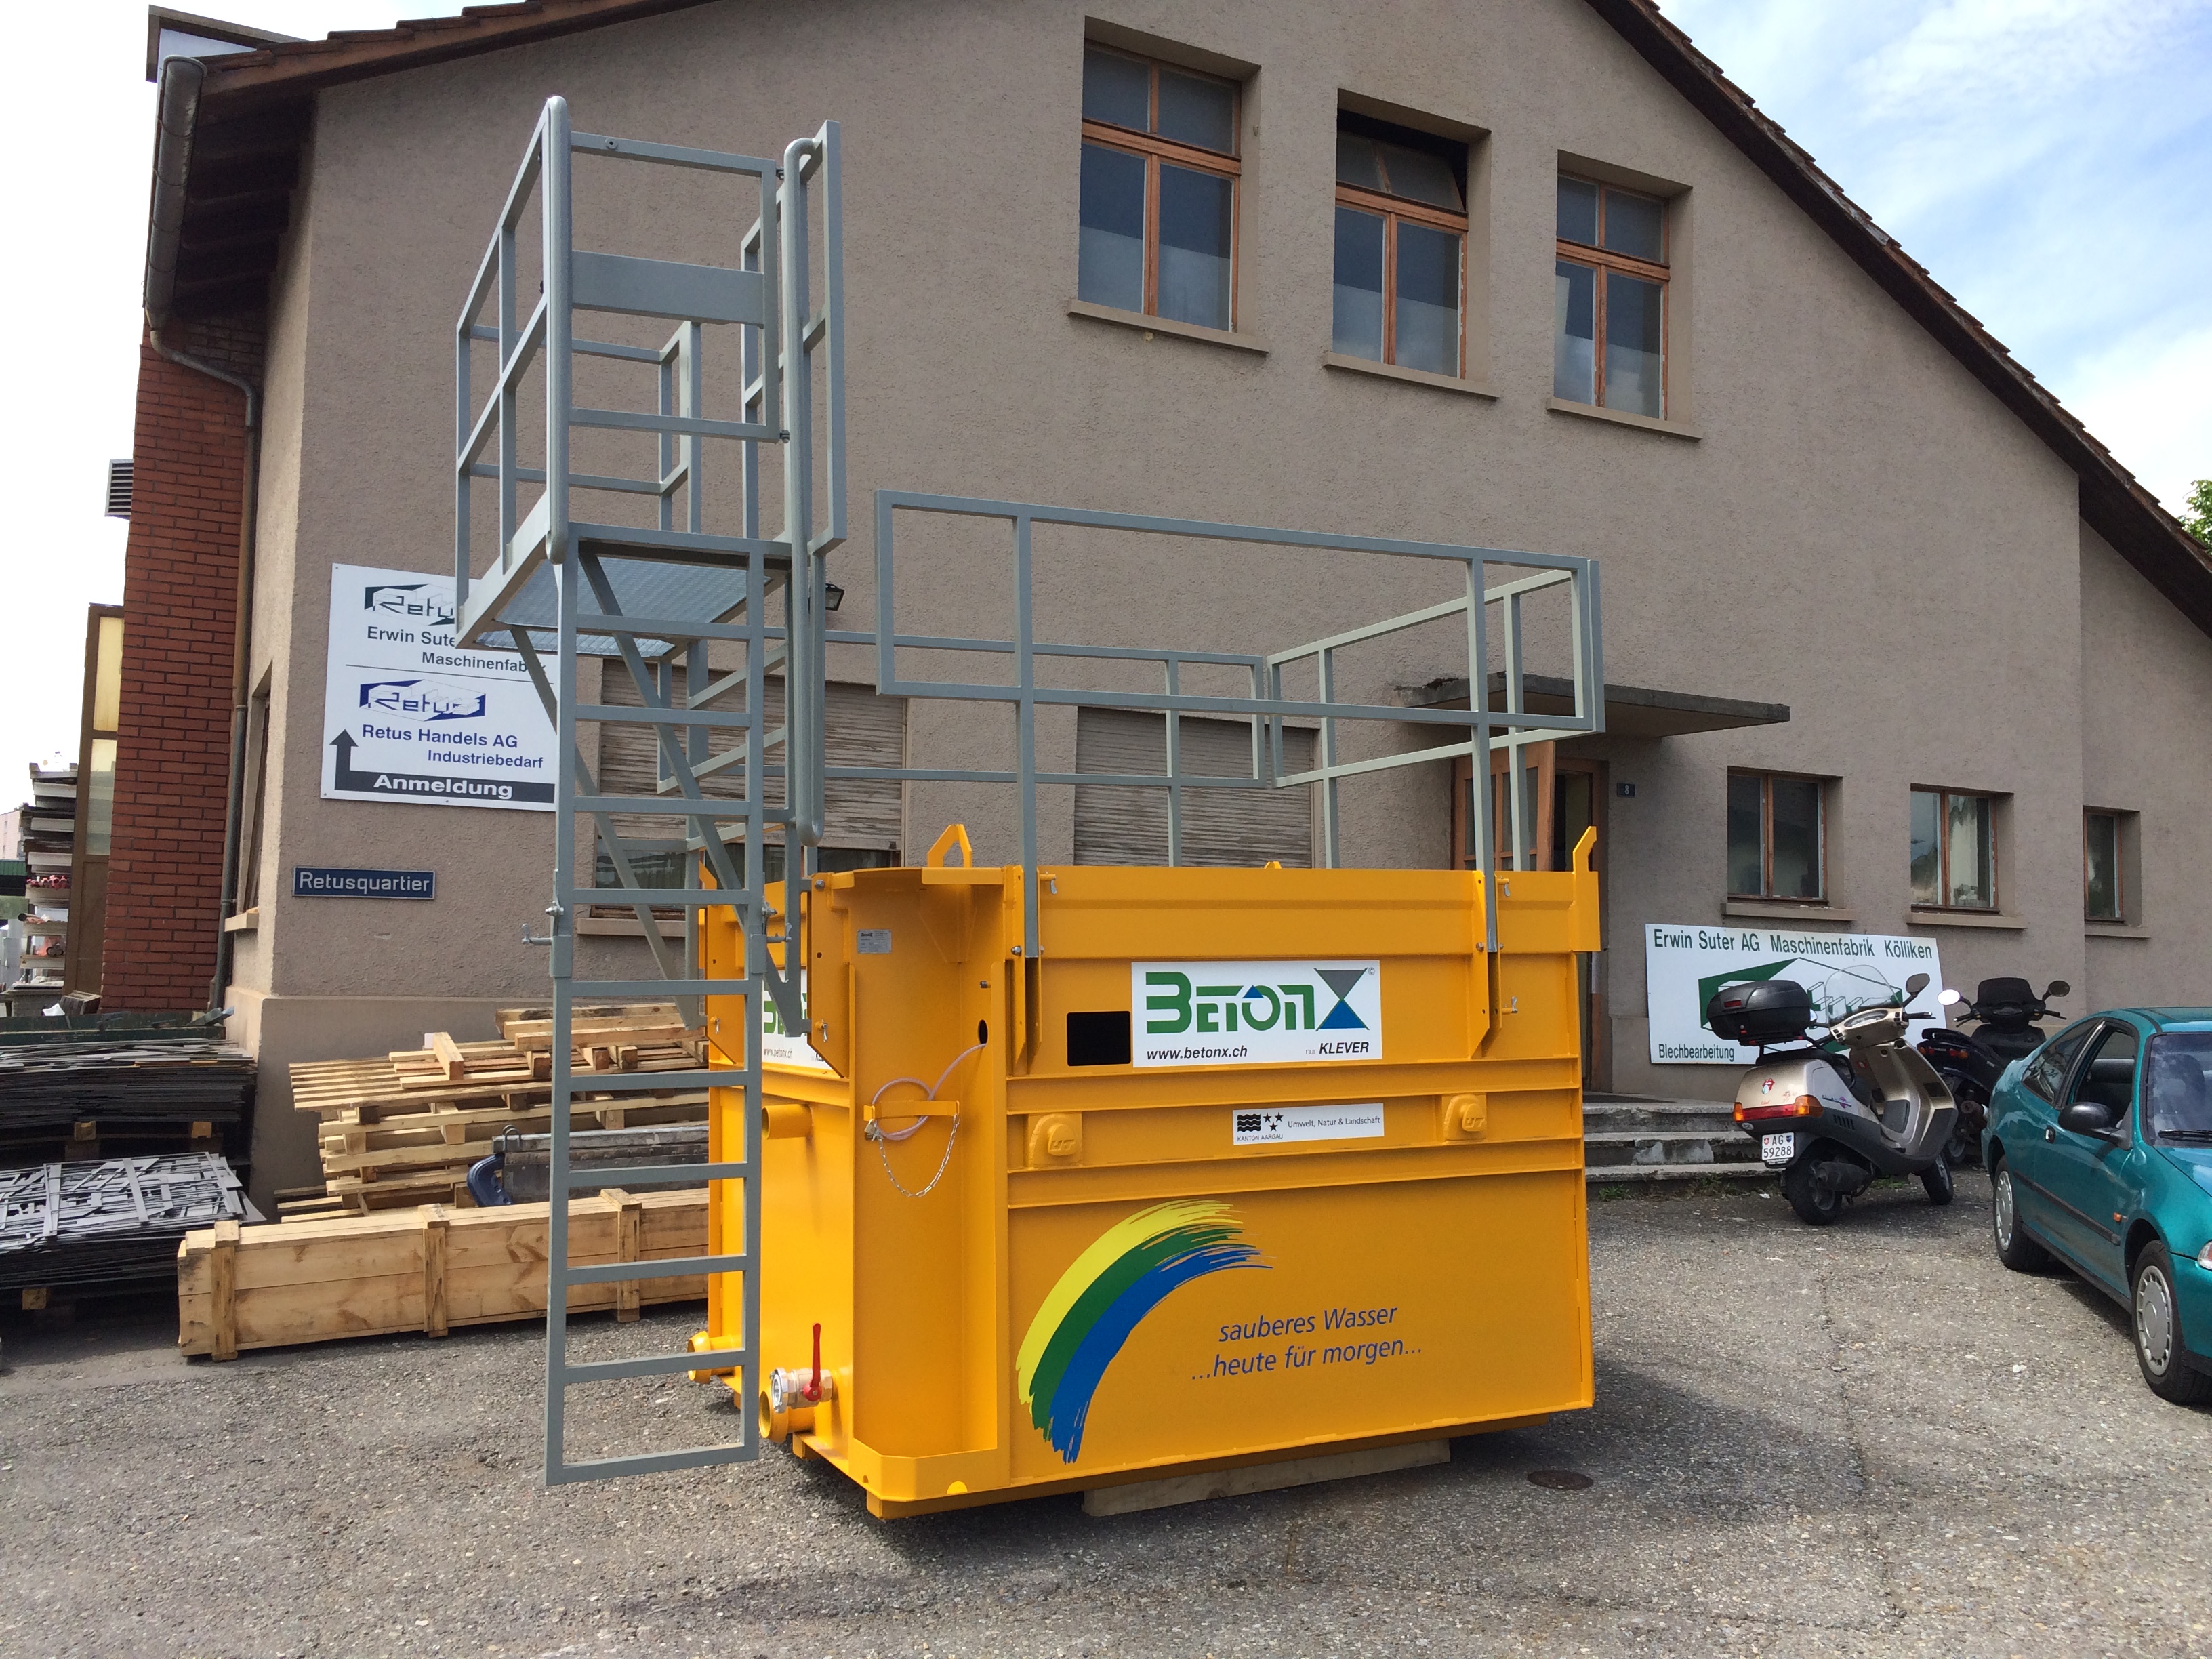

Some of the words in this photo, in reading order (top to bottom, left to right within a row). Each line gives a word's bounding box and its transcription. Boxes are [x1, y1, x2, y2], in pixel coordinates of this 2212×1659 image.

[367, 626, 415, 643] Erwin
[420, 630, 456, 648] Sute
[362, 724, 412, 741] Retus
[418, 729, 487, 745] Handels
[493, 735, 518, 748] AG
[428, 749, 544, 769] Industriebedarf
[373, 774, 513, 799] Anmeldung
[1624, 785, 1630, 795] 8
[299, 872, 430, 895] Retusquartier
[1654, 929, 1692, 949] Erwin
[1698, 930, 1735, 951] Suter
[1741, 933, 1760, 951] AG
[1770, 935, 1875, 956] Maschinenfabrik
[1884, 940, 1933, 959] Kölliken
[1147, 1044, 1248, 1060] www.betonx.ch
[1319, 1042, 1369, 1054] KLEVER
[1658, 1044, 1734, 1062] Blechbearbeitung
[1288, 1119, 1315, 1128] Umwelt,
[1317, 1118, 1336, 1126] Natur
[1345, 1116, 1380, 1124] Landschaft
[1772, 1135, 1784, 1145] AG
[1763, 1146, 1792, 1158] 59288
[1218, 1315, 1315, 1343] sauberes
[1324, 1307, 1397, 1330] Wasser
[1285, 1345, 1316, 1370] für
